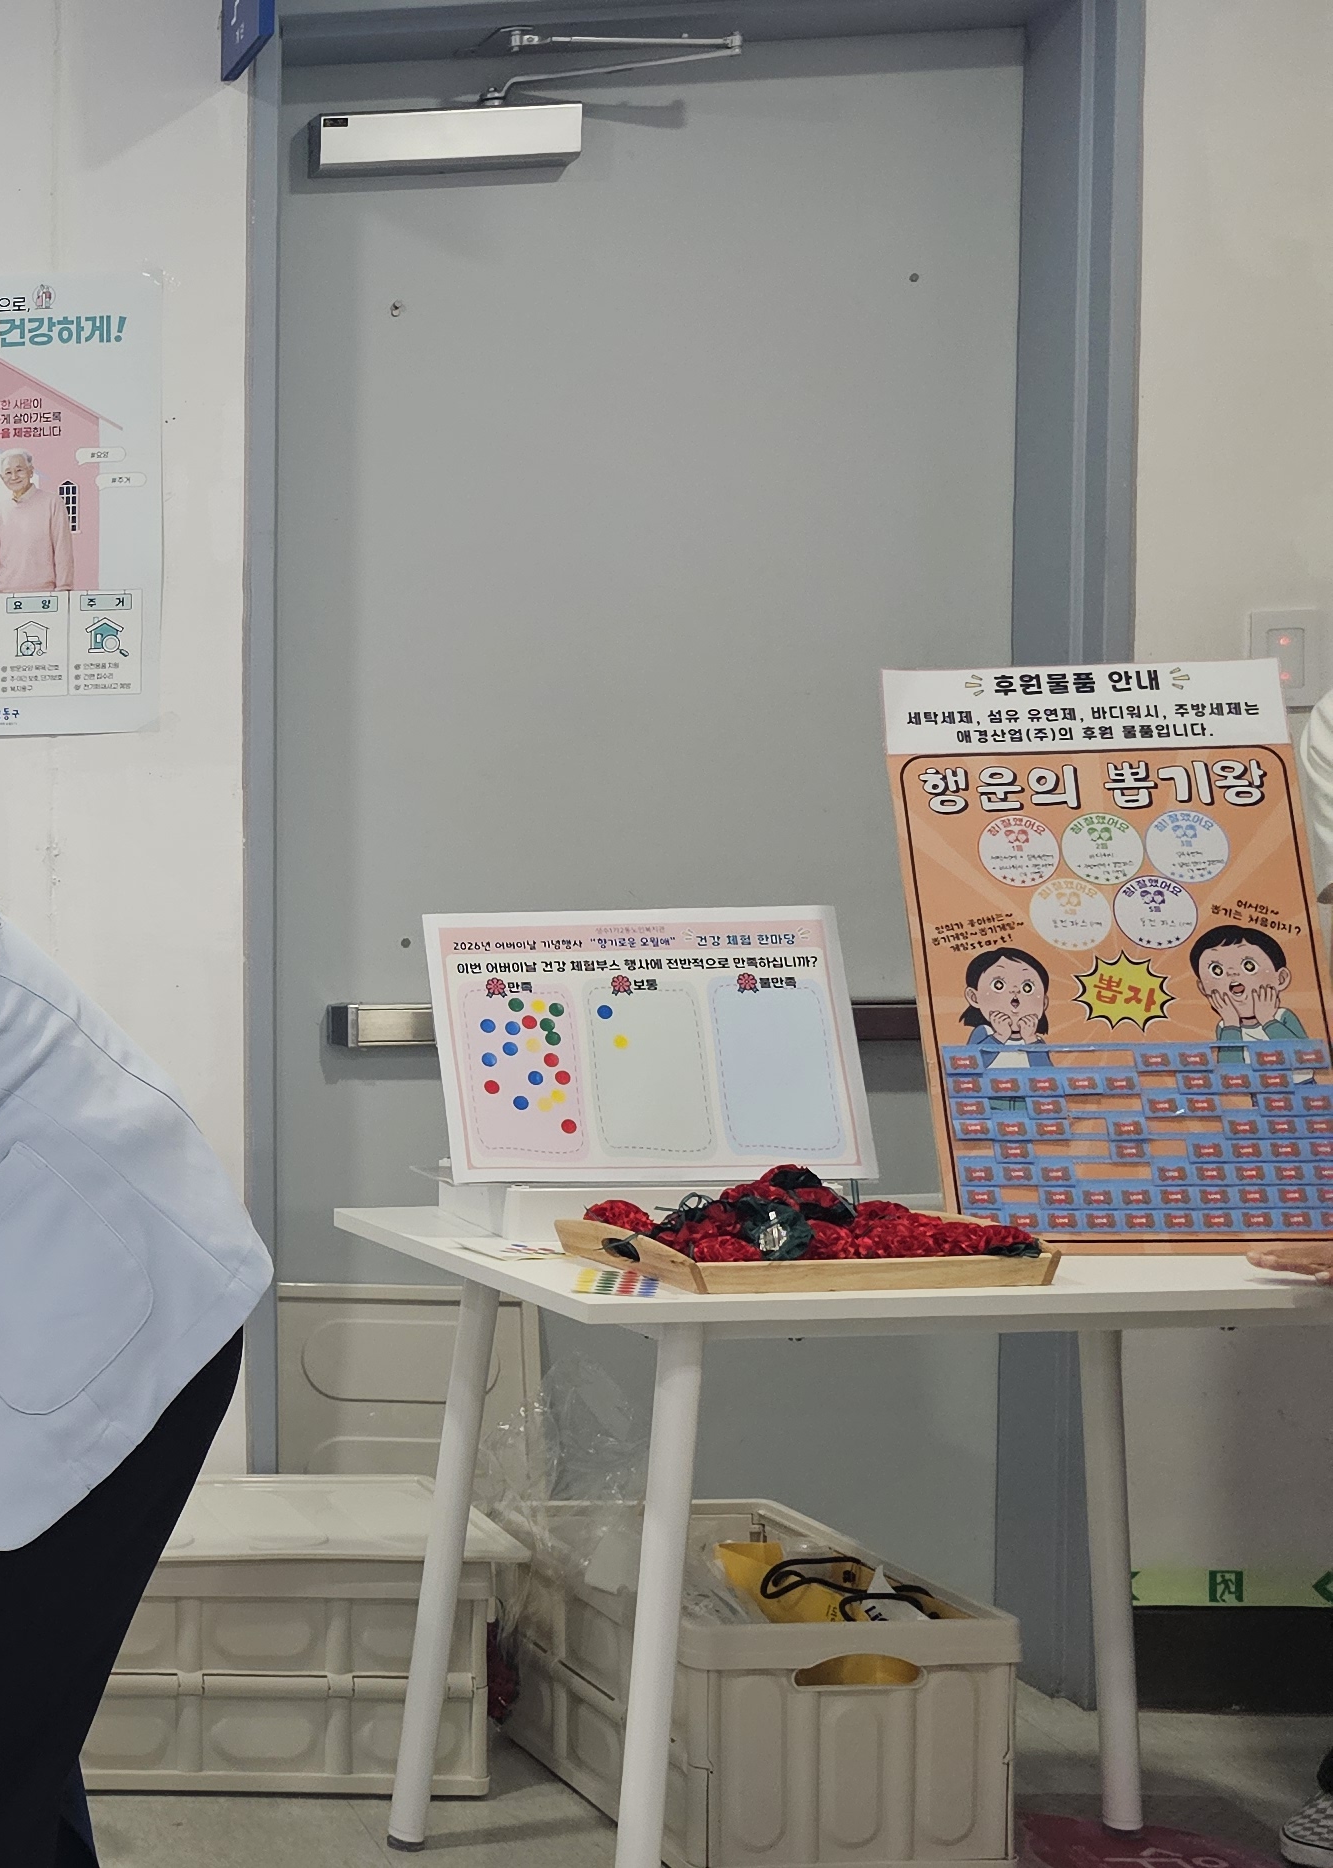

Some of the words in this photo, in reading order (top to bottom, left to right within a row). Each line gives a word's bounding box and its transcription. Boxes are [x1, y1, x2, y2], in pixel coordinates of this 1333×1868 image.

[0, 315, 128, 347] 건강하게!
[13, 398, 42, 411] 사람이
[13, 411, 62, 424] 살아가도록
[13, 426, 62, 438] 제공합니다
[994, 672, 1095, 696] 후원물품
[1108, 670, 1160, 692] 안내
[907, 710, 981, 726] 세탁세제,
[988, 709, 1020, 723] 섬유
[1027, 707, 1084, 723] 유연제,
[1091, 704, 1167, 720] 바디워시,
[1174, 701, 1260, 717] 주방세제는
[956, 727, 1074, 743] 애경산업(주)의
[1082, 725, 1114, 740] 후원
[1122, 722, 1214, 739] 물품입니다.
[919, 764, 1081, 814] 행운의
[1104, 758, 1267, 809] 뽑기왕
[1236, 899, 1280, 915] 어서와~
[1210, 903, 1243, 921] 뽑기는
[1248, 914, 1301, 936] 처음이지?
[453, 940, 491, 952] 2026년
[494, 940, 537, 951] 어버이날
[541, 938, 583, 949] 기념행사
[695, 934, 721, 946] 건강
[727, 934, 752, 946] 체험
[757, 932, 796, 945] 한마당
[457, 962, 482, 975] 이번
[486, 961, 537, 974] 어버이날
[541, 961, 567, 973] 건강
[570, 959, 621, 972] 체험부스
[623, 958, 663, 971] 행사에
[666, 957, 730, 970] 전반적으로
[733, 956, 818, 969] 만족하십니까?
[507, 981, 532, 993] 만족
[633, 979, 658, 991] 보통
[759, 977, 797, 989] 불만족
[1093, 974, 1158, 1013] 뽑자
